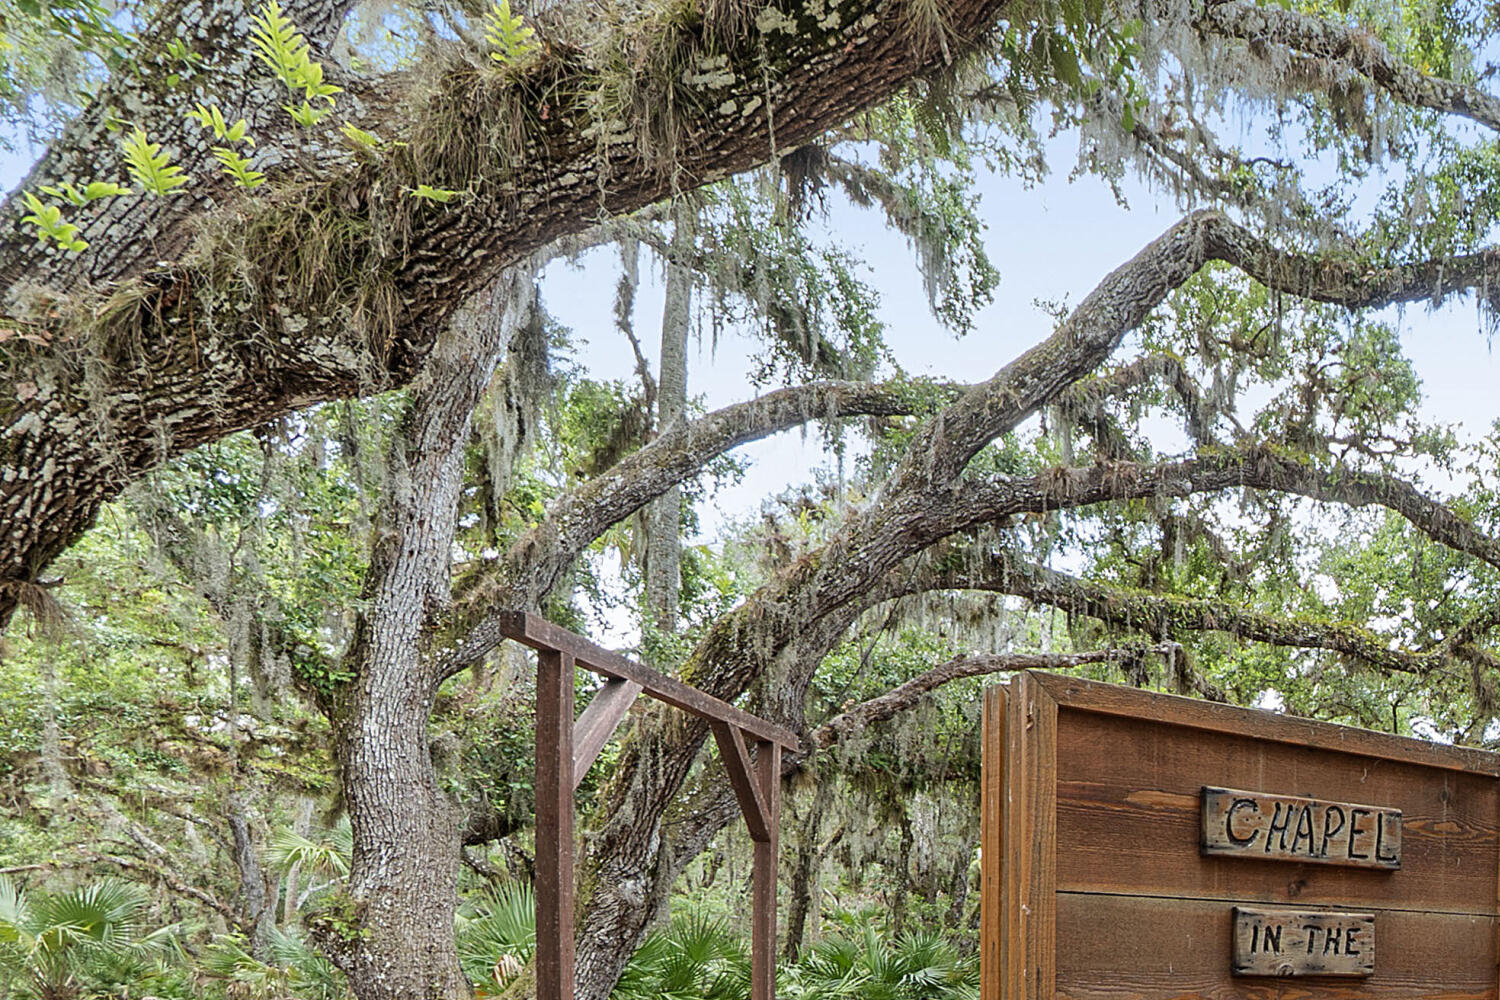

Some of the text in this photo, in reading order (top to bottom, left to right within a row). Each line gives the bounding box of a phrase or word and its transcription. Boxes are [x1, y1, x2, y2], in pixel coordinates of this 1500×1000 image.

[1225, 798, 1397, 862] CHAPEL
[1250, 924, 1362, 957] IN THE
